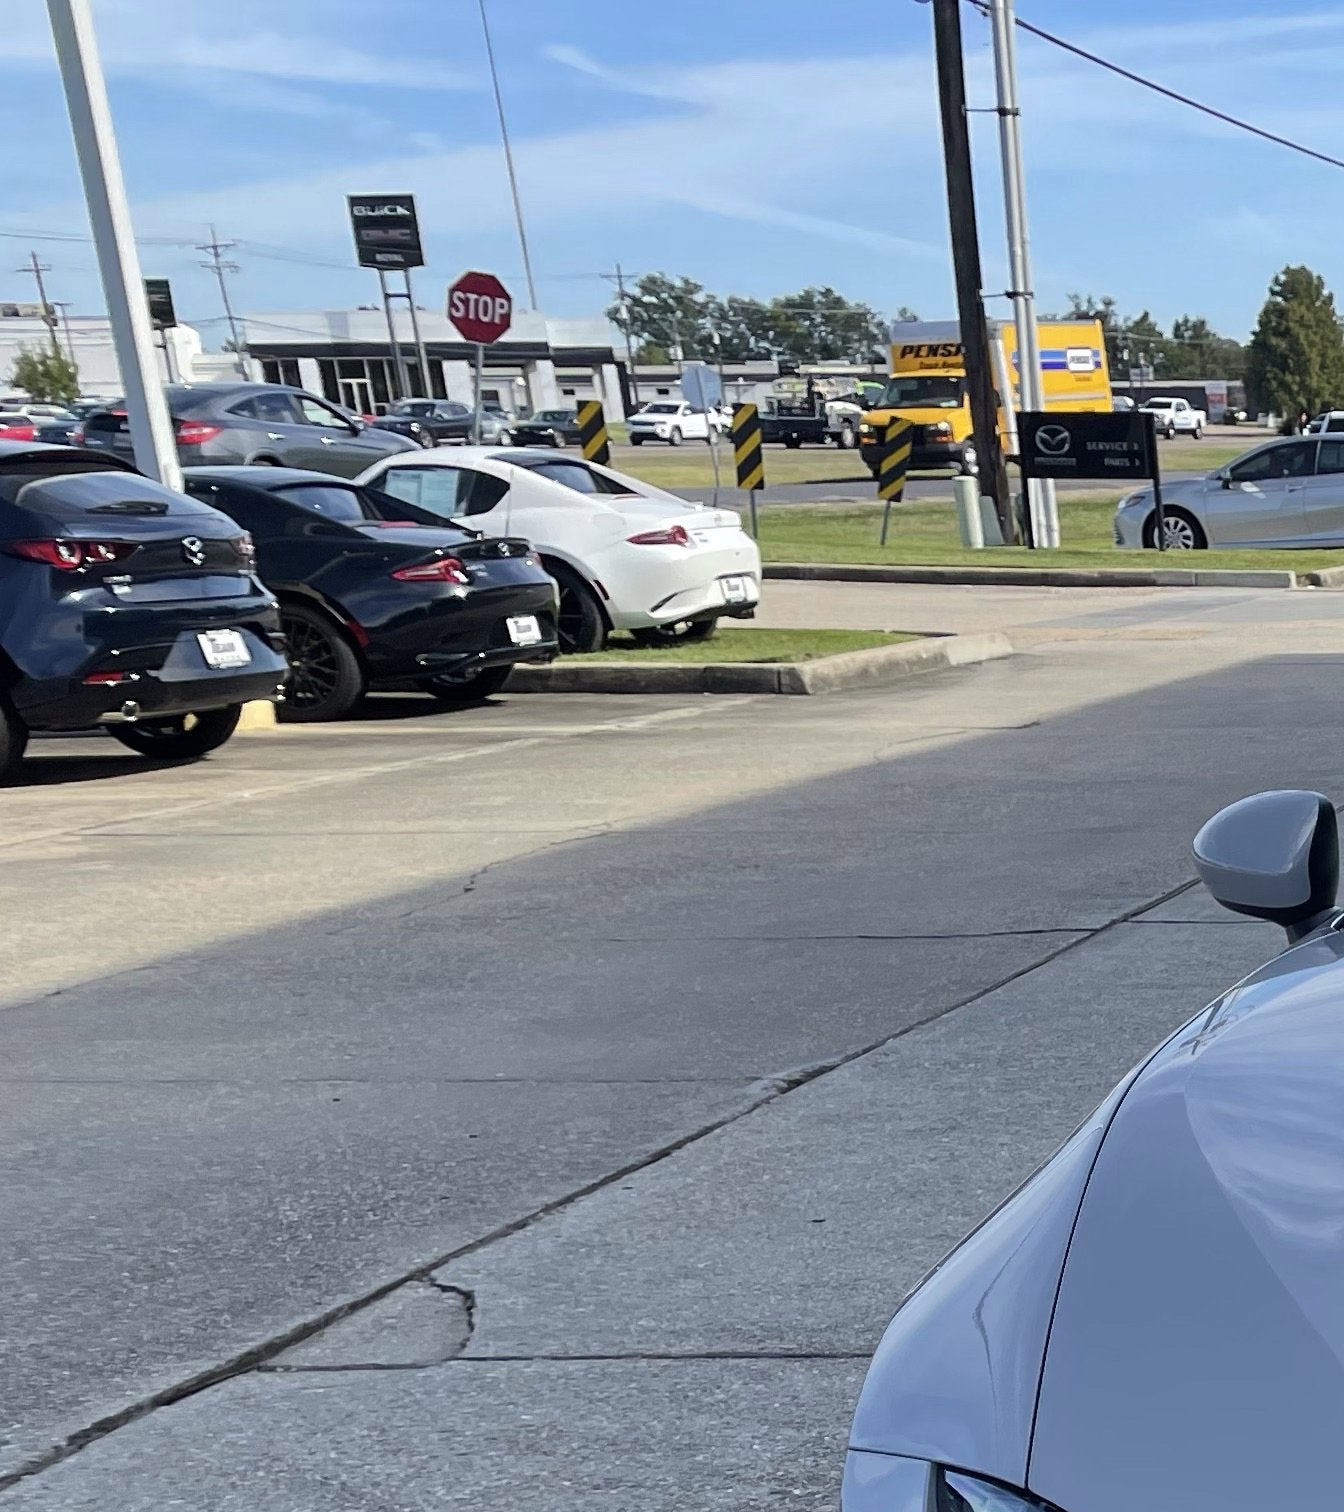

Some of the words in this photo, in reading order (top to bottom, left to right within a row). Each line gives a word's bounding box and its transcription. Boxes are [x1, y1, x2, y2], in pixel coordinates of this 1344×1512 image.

[352, 205, 412, 217] BUICK
[450, 289, 509, 325] STOP
[1085, 441, 1128, 451] SERVICE
